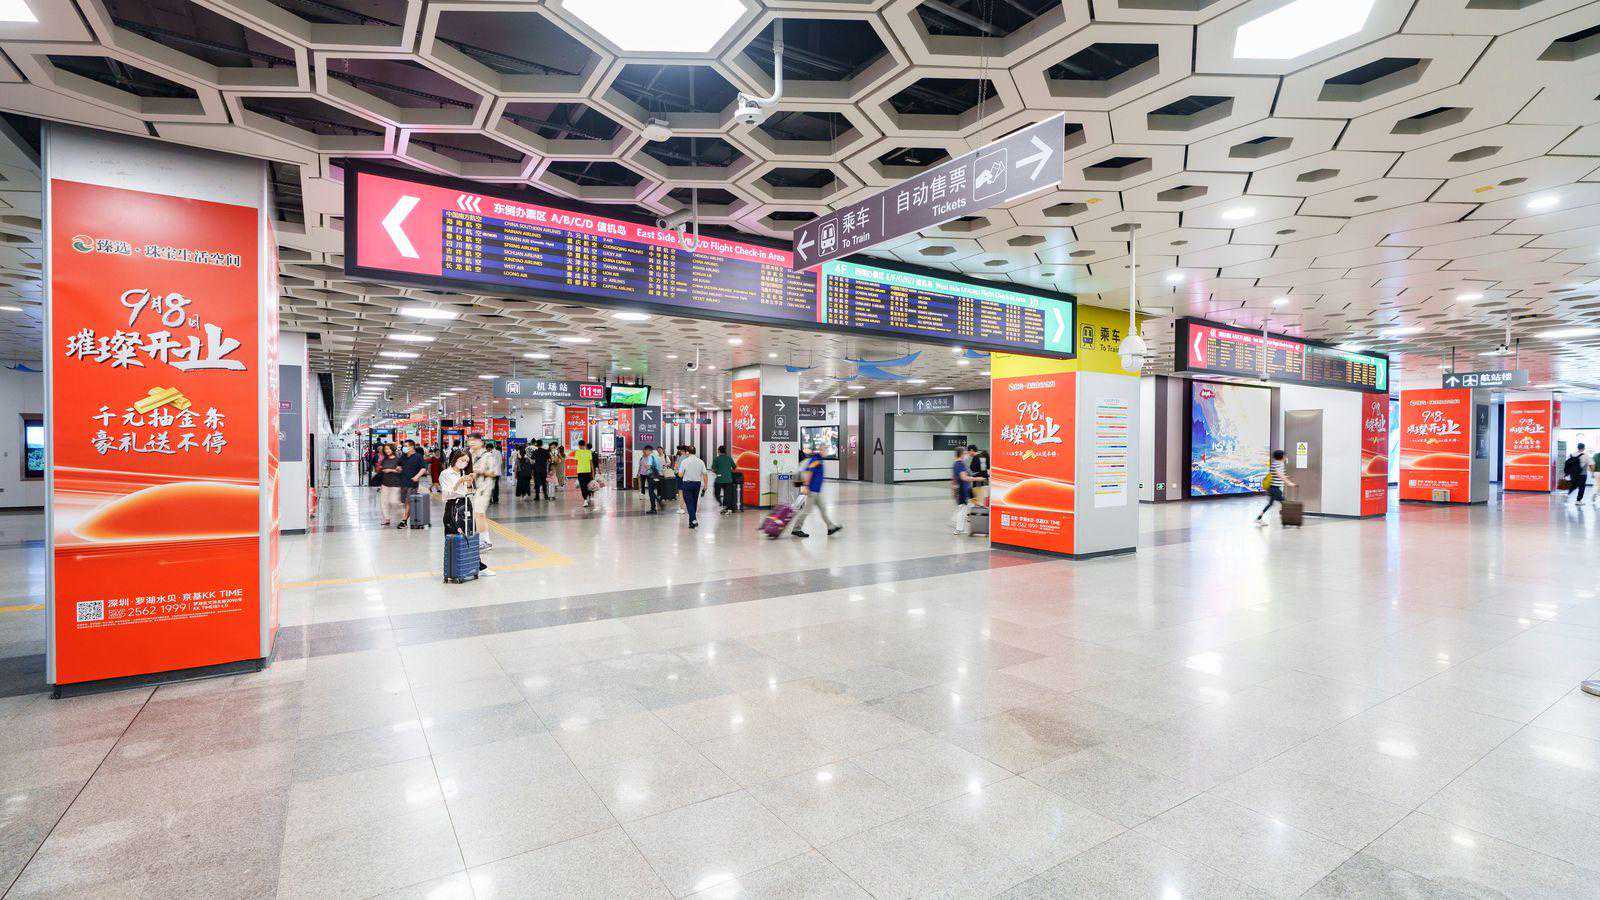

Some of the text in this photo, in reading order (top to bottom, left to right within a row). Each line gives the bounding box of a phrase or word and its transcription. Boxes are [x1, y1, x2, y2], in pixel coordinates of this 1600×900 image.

[896, 164, 968, 215] 自动售票
[932, 197, 967, 218] Tickets
[551, 213, 594, 229] A/B/C/D
[842, 207, 871, 234] 乘车
[636, 228, 655, 239] East
[657, 233, 676, 243] Side
[710, 241, 733, 253] Flight
[734, 245, 767, 259] Check-in
[768, 252, 786, 262] Area
[842, 231, 871, 249] To Train
[1100, 327, 1121, 343] 乘车
[1481, 372, 1512, 381] 航站楼
[537, 382, 568, 391] 机场站
[92, 405, 226, 429] 千元抽金条
[91, 431, 228, 455] 豪礼送不停
[873, 437, 884, 455] A
[219, 588, 243, 598] TIME
[128, 606, 157, 617] 2562
[160, 603, 187, 614] 1999
